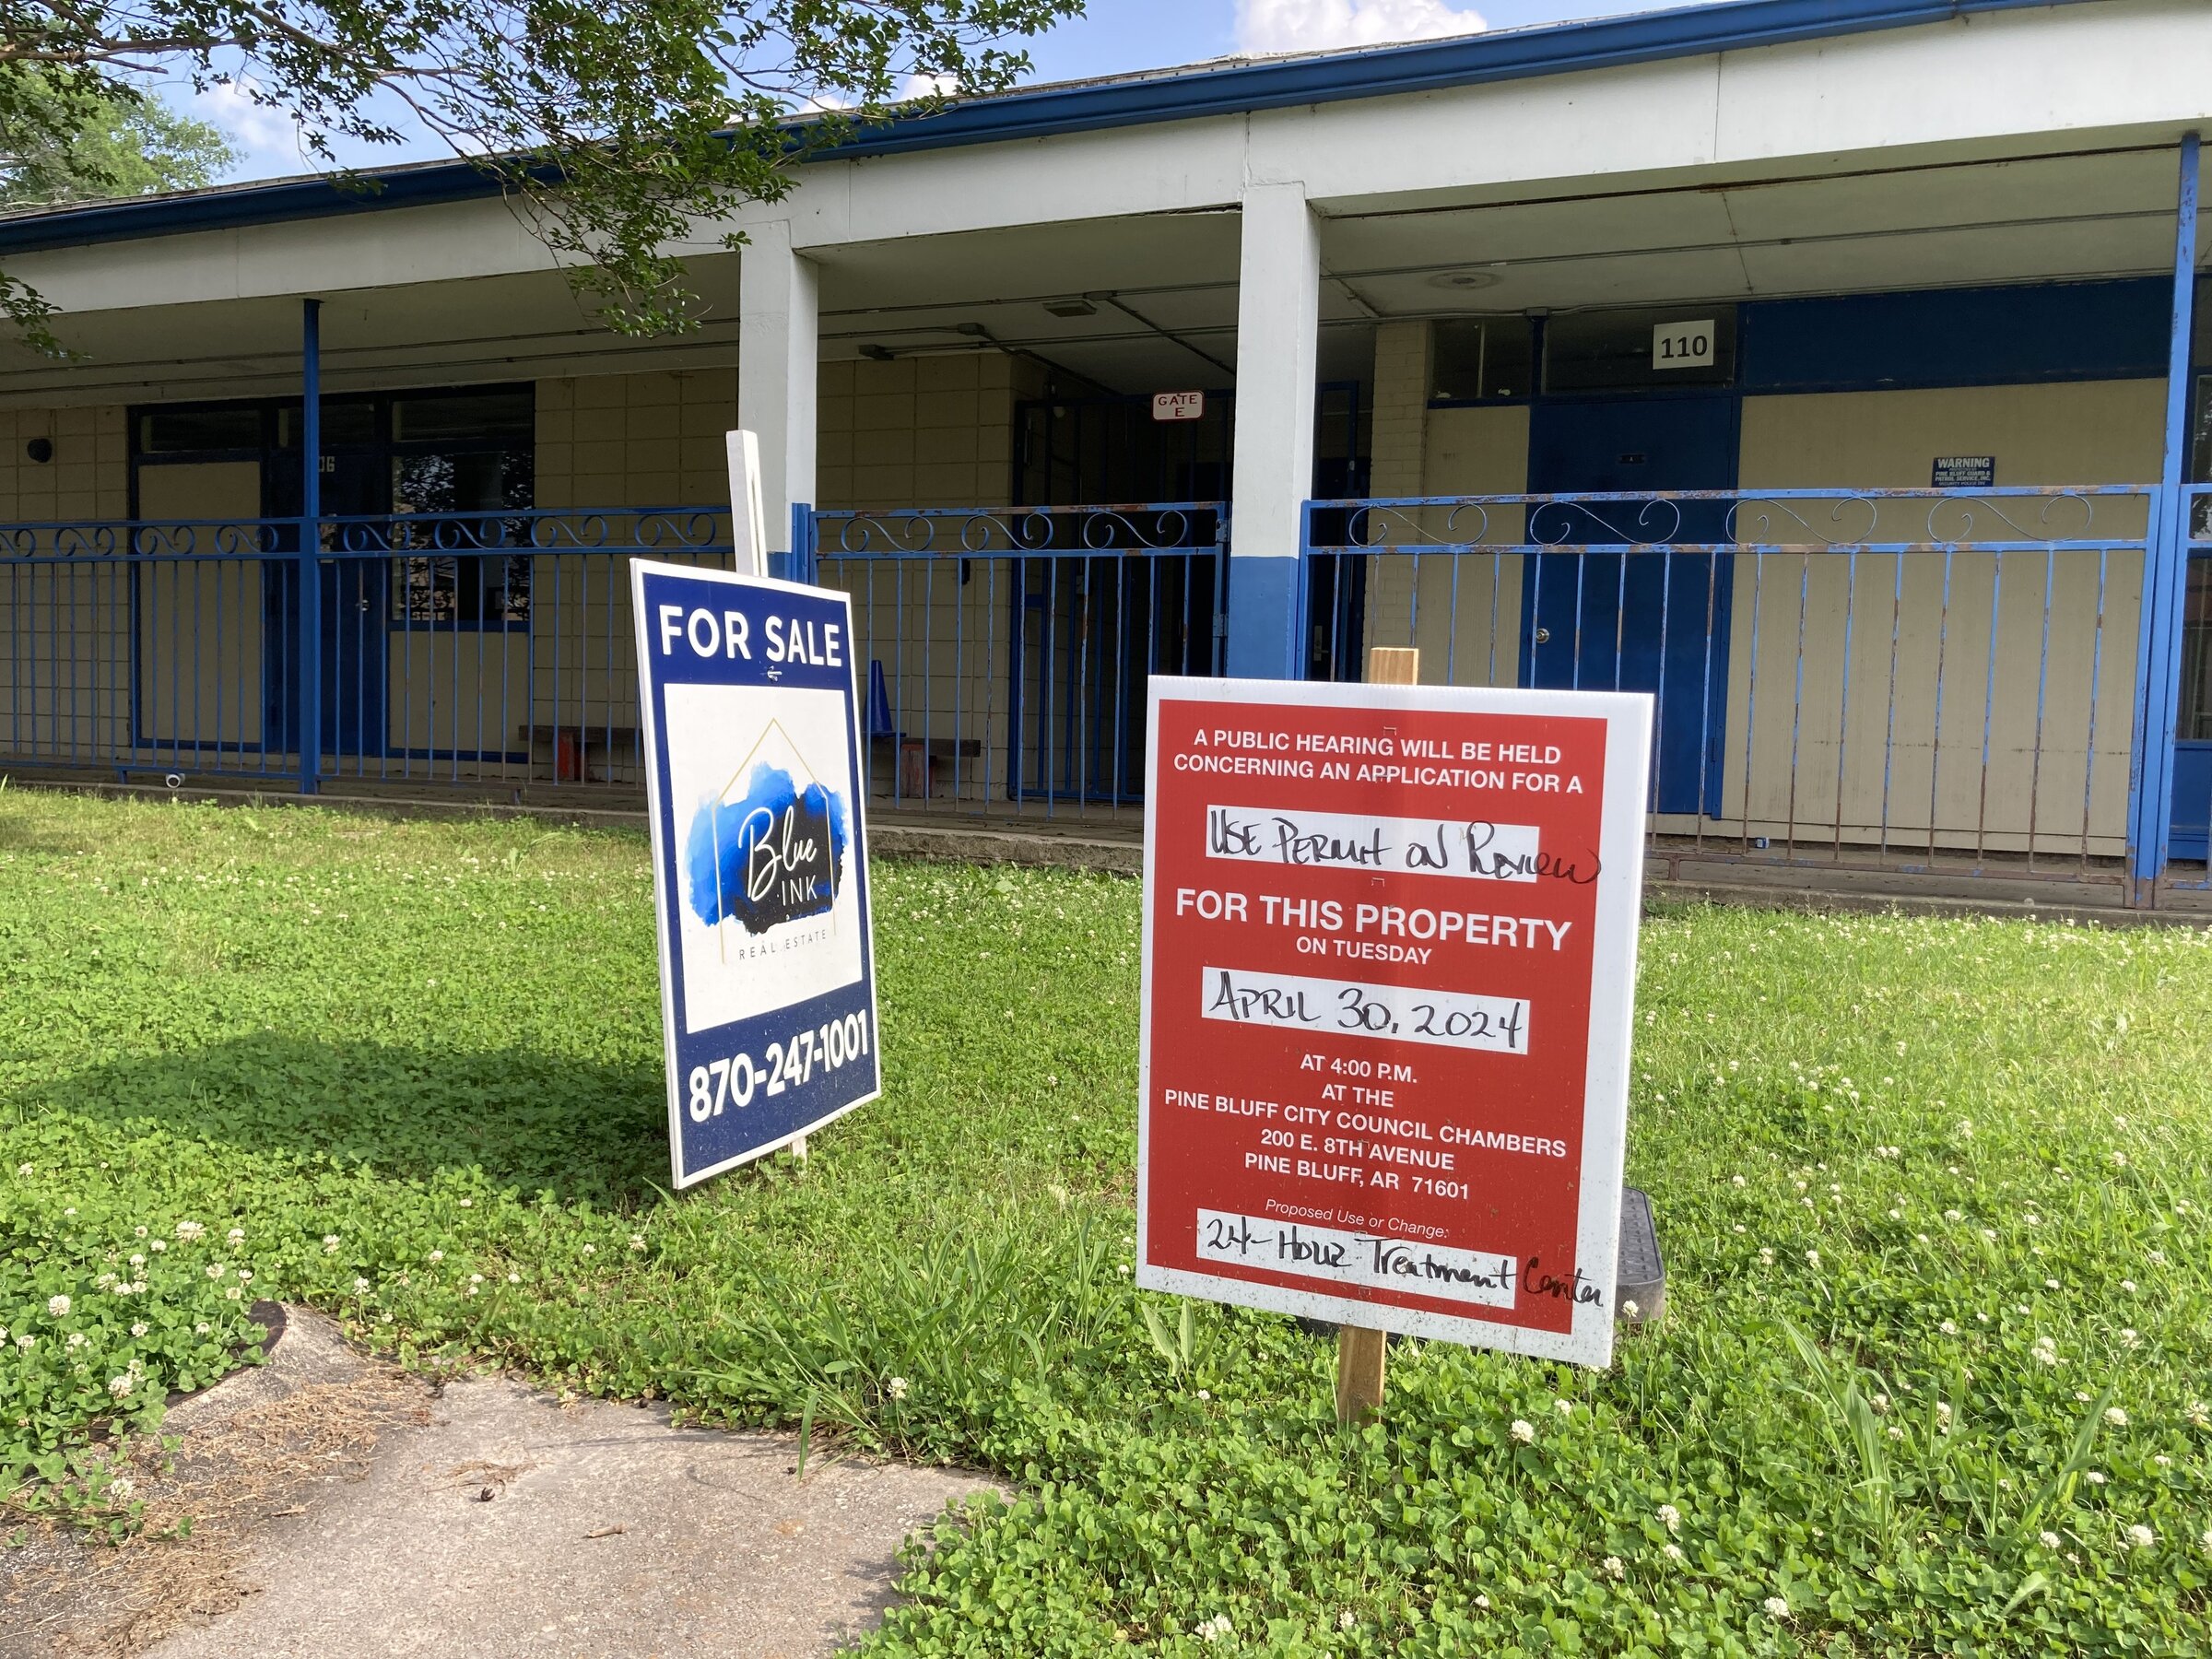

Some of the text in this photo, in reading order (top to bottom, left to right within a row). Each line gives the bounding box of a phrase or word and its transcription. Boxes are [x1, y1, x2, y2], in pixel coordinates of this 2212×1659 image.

[1661, 335, 1708, 359] 110
[1158, 394, 1197, 406] GATE
[1175, 407, 1184, 417] E
[1937, 457, 1990, 468] WARNING
[659, 605, 842, 667] FOR SALE
[1194, 729, 1561, 764] A PUBLIC HEARING WILL BE HELD
[1174, 754, 1583, 794] CONCERNING AN APPLICATION FOR A
[738, 806, 818, 901] Blue
[782, 875, 818, 906] INK
[1176, 888, 1572, 951] FOR THIS PROPERTY
[739, 929, 827, 960] REAL ESTATE
[1296, 936, 1432, 965] ON TUESDAY
[1412, 1001, 1522, 1048] 2024
[689, 1009, 868, 1123] 870-247-1001
[1300, 1053, 1418, 1083] AT 4:00 P.M.
[1321, 1084, 1394, 1108] AT THE
[1165, 1089, 1566, 1158] PINE BLUFF CITY COUNCIL CHAMBERS
[1261, 1128, 1454, 1171] 200 E. 8TH AVENUE
[1245, 1152, 1468, 1200] PINE BLUFF, AR 71601
[1265, 1198, 1450, 1240] Proposed Use or Change:
